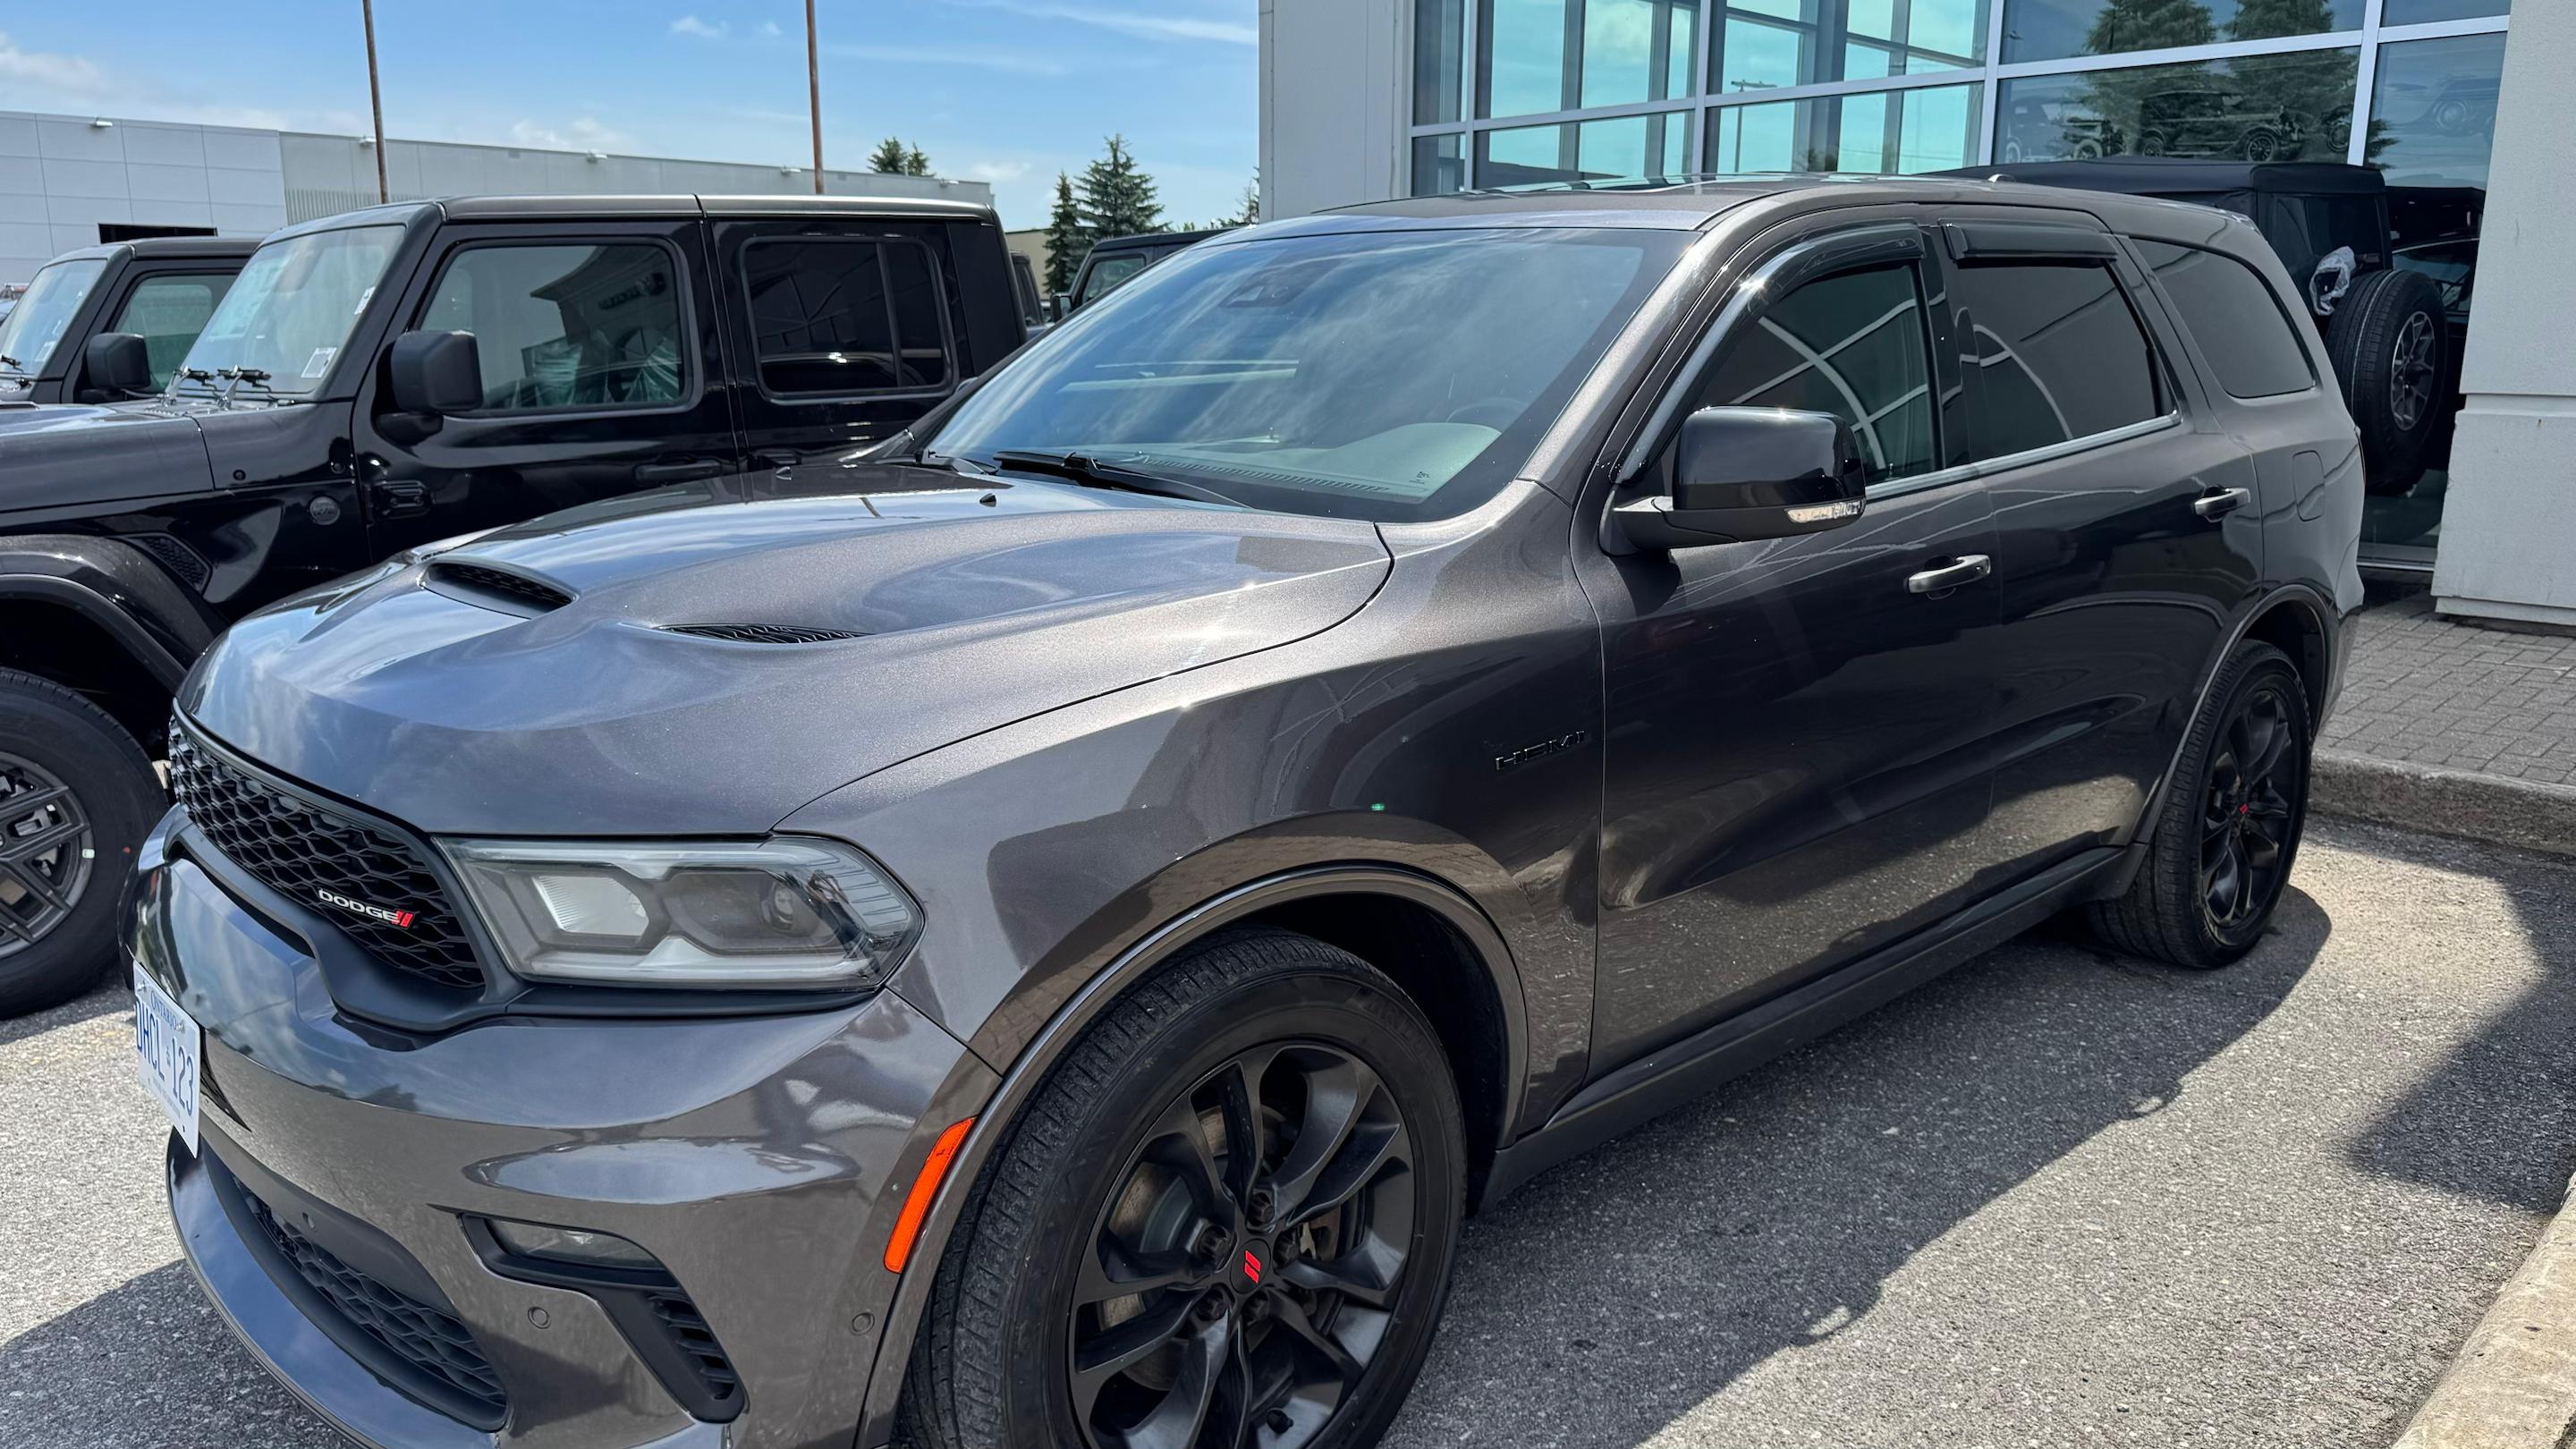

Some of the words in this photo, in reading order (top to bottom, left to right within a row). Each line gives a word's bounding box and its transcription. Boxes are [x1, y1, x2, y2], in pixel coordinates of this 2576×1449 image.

[1496, 730, 1585, 771] HEMI
[318, 888, 400, 924] DODGE
[150, 990, 177, 1030] ONTARIO
[172, 1038, 194, 1116] 123
